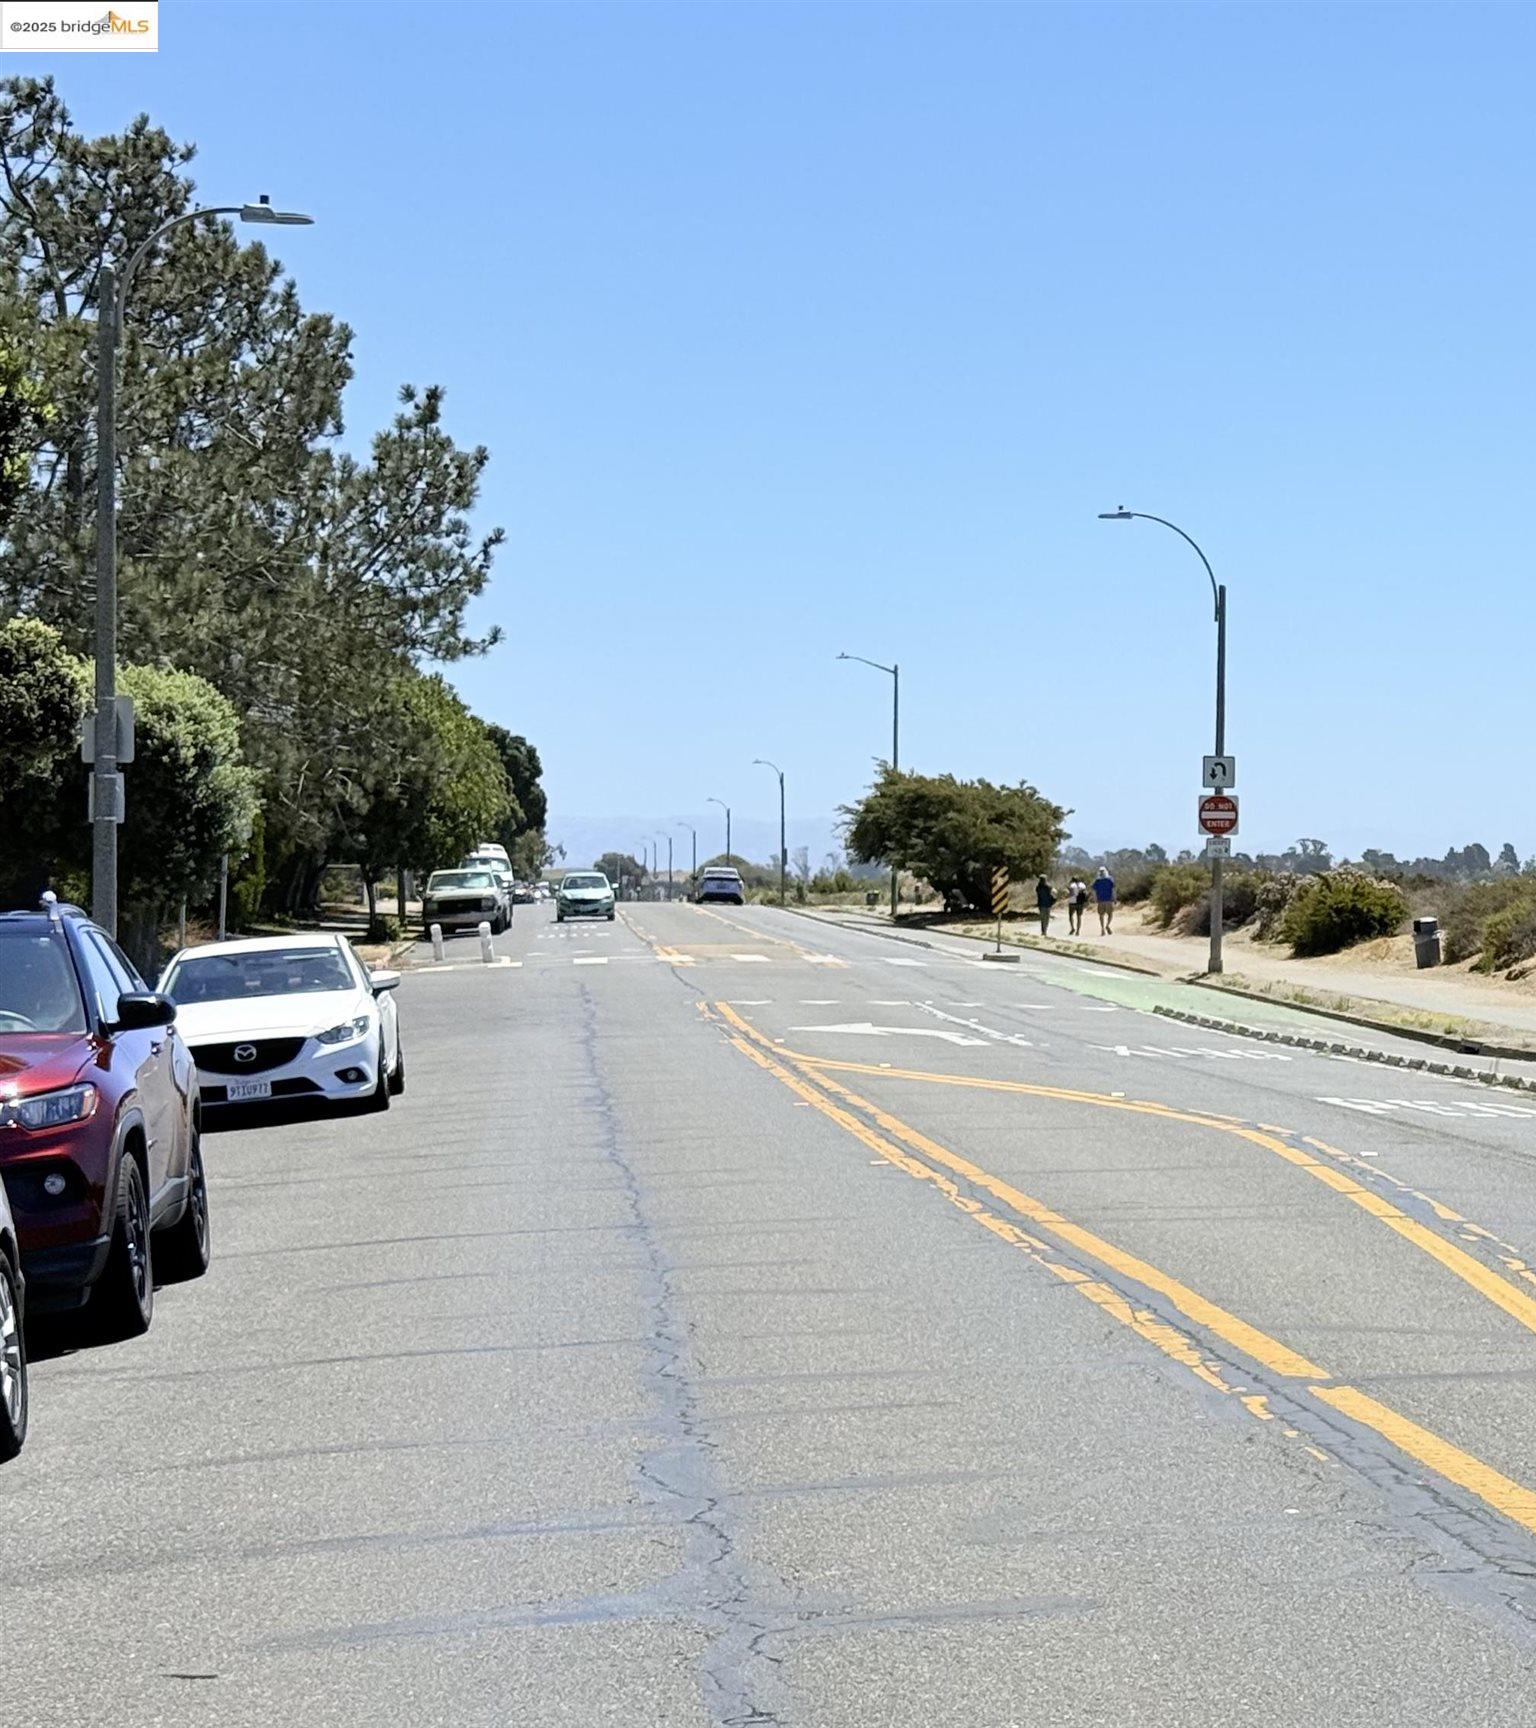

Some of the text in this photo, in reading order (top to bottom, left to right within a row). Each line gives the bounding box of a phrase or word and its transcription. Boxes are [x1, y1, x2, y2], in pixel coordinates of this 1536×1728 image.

[1204, 802, 1232, 810] DO NOT
[1207, 820, 1230, 828] ENTER
